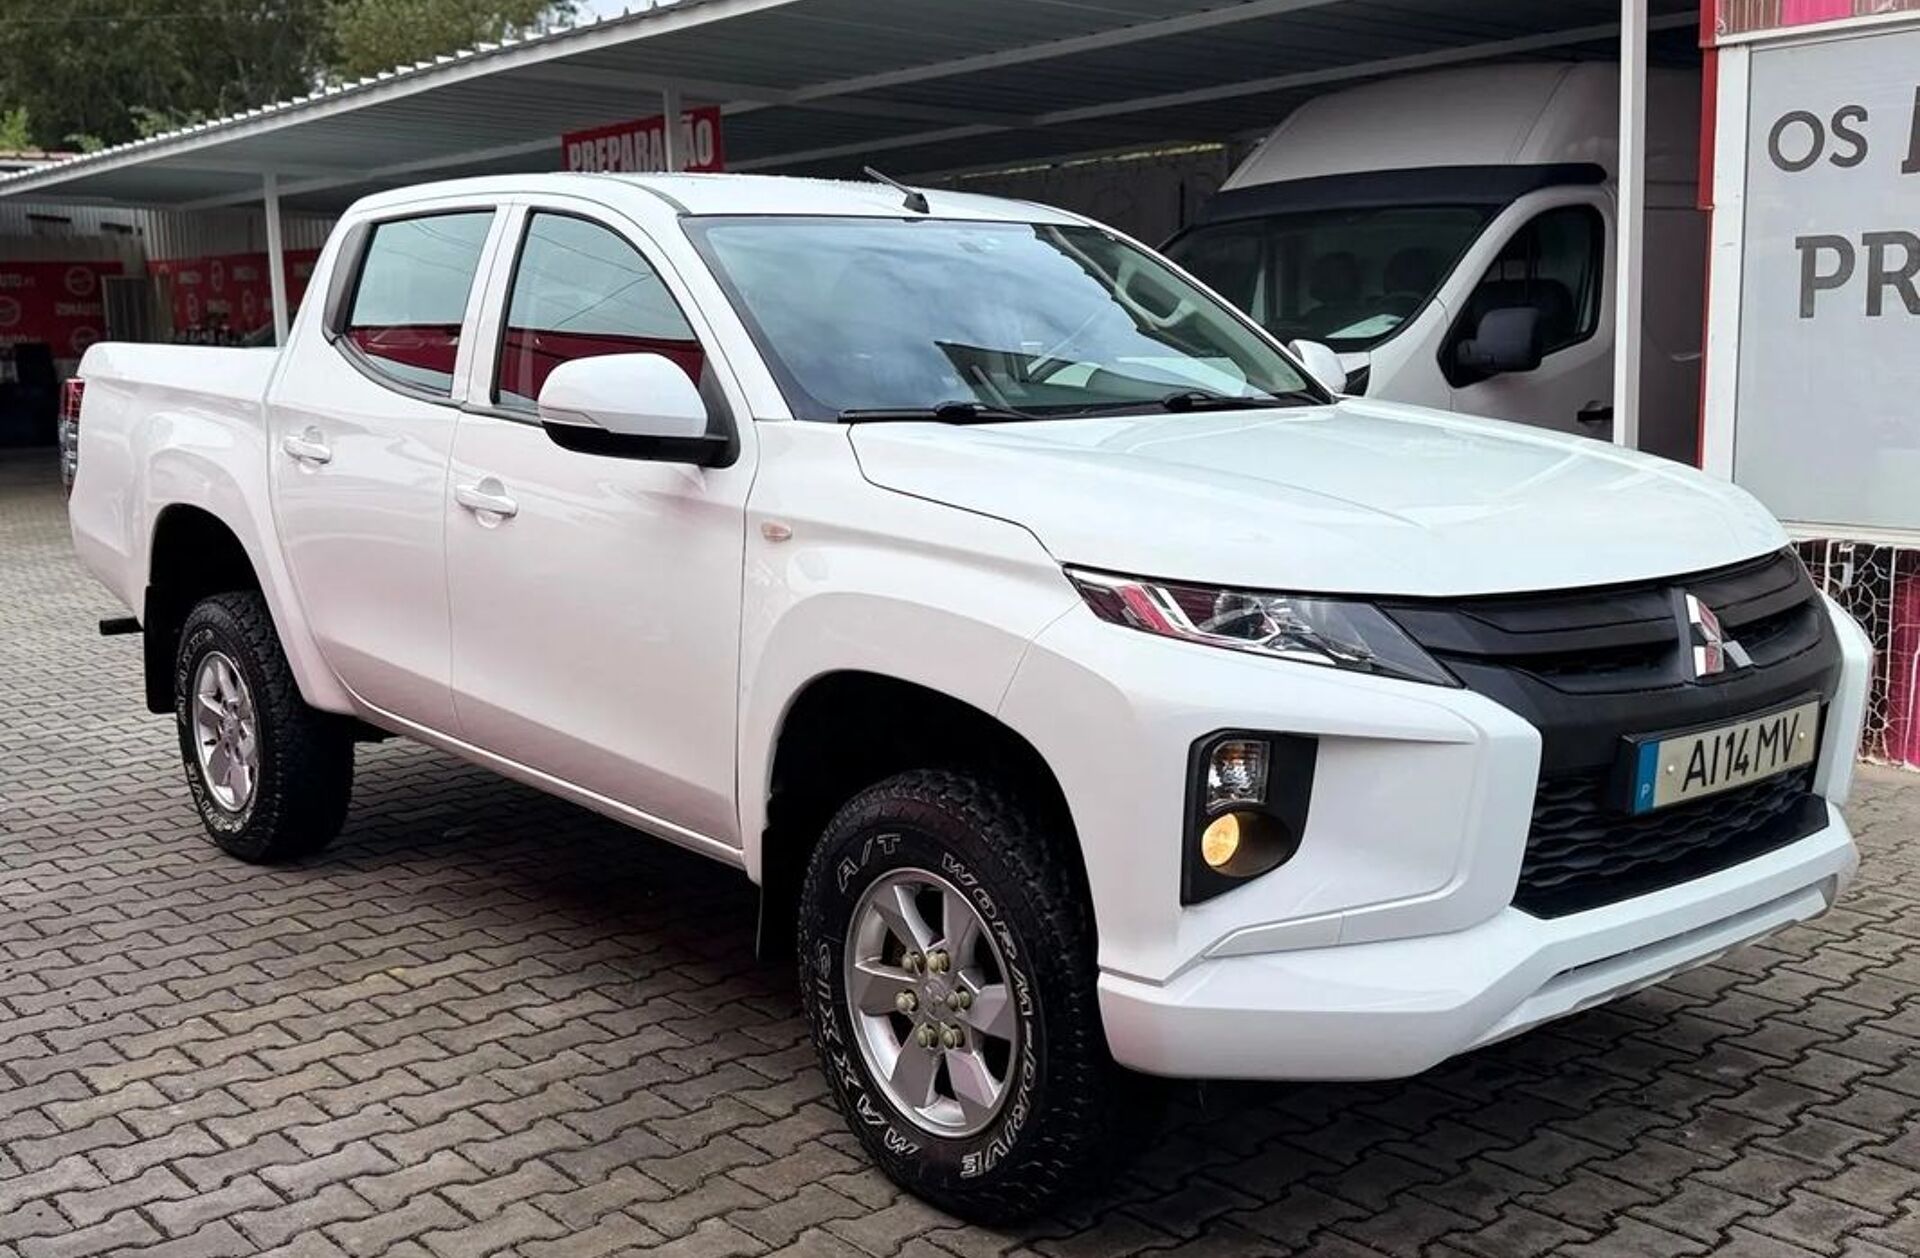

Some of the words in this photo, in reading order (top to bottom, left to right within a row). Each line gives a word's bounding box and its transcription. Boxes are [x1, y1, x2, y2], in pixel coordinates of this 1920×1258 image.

[1768, 105, 1868, 172] OS
[1795, 231, 1920, 319] PR
[1640, 783, 1651, 798] P
[817, 942, 919, 1155] MAXXIS
